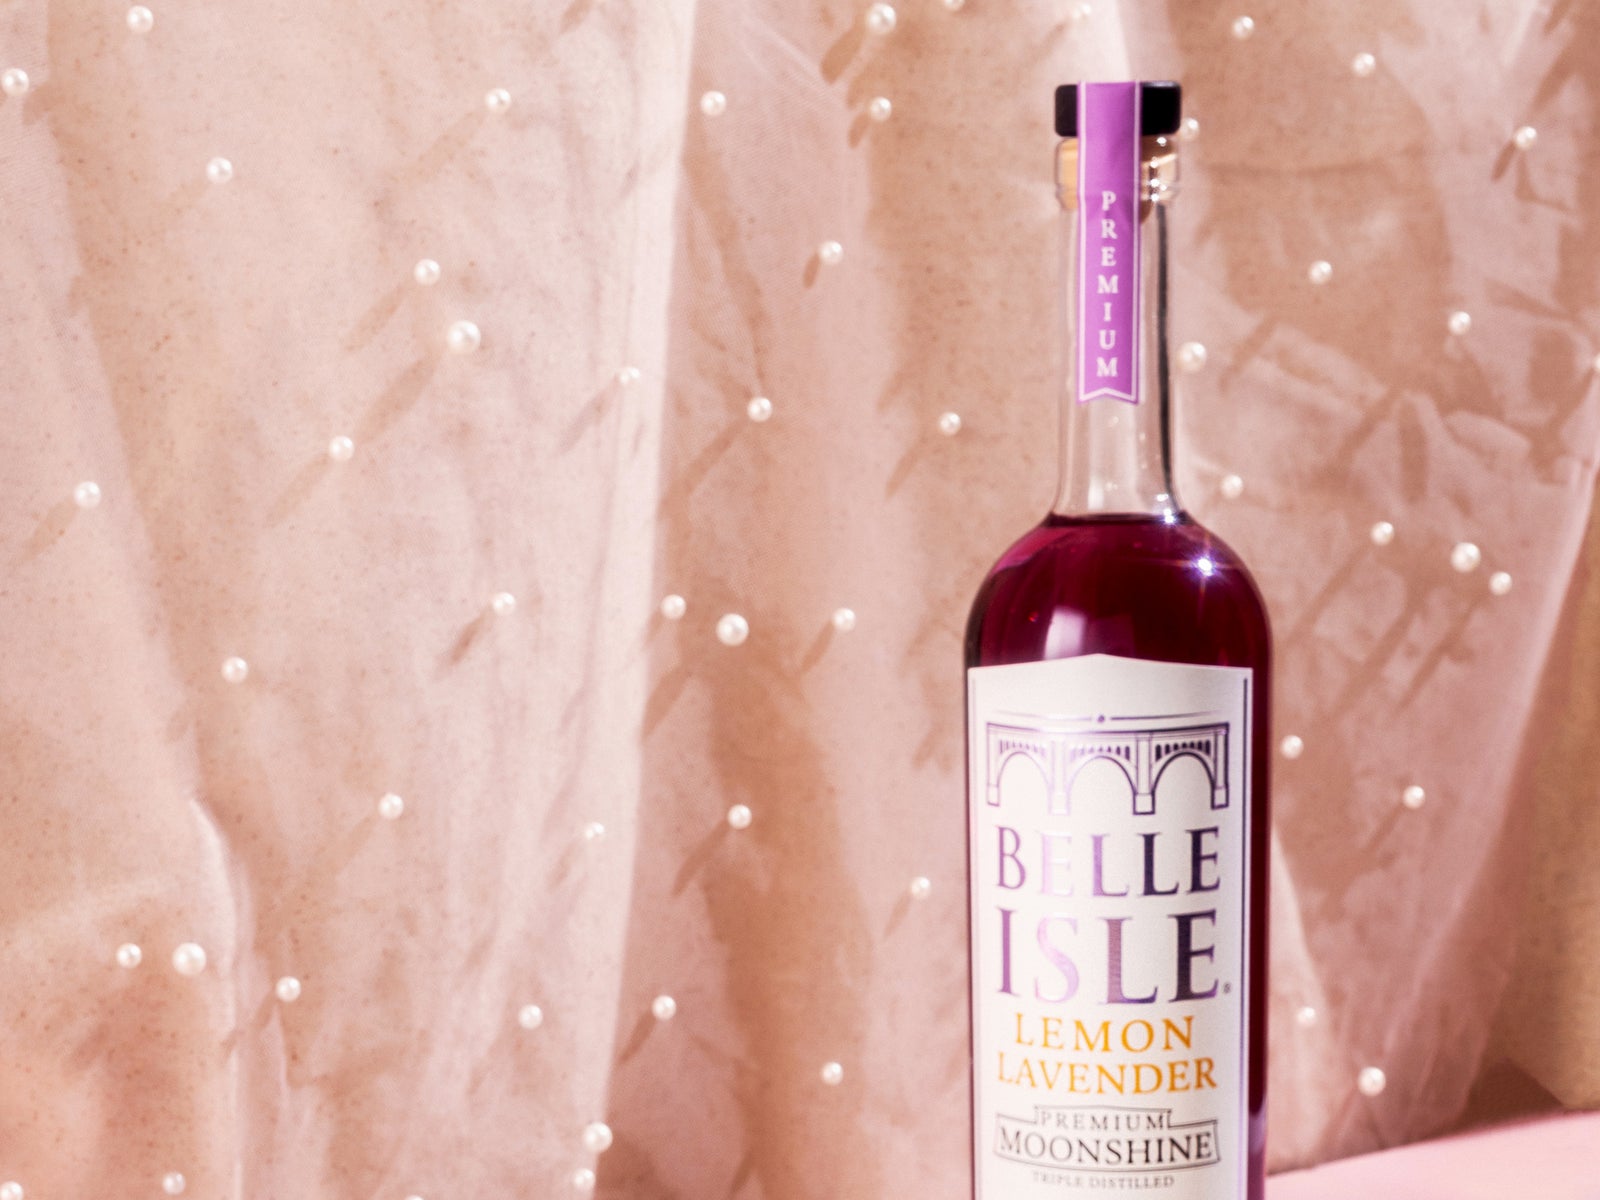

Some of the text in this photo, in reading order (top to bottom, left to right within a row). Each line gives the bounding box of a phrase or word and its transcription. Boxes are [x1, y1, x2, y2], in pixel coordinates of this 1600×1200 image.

[1097, 190, 1119, 378] PREMIUM
[996, 825, 1221, 898] BELLE
[1015, 1012, 1194, 1053] LEMON
[997, 1051, 1218, 1095] LAVENDER
[1040, 1110, 1165, 1131] PREMIUM
[999, 1126, 1213, 1166] MOONSHINE
[1032, 1171, 1175, 1190] TRIPLE DISTILLED
